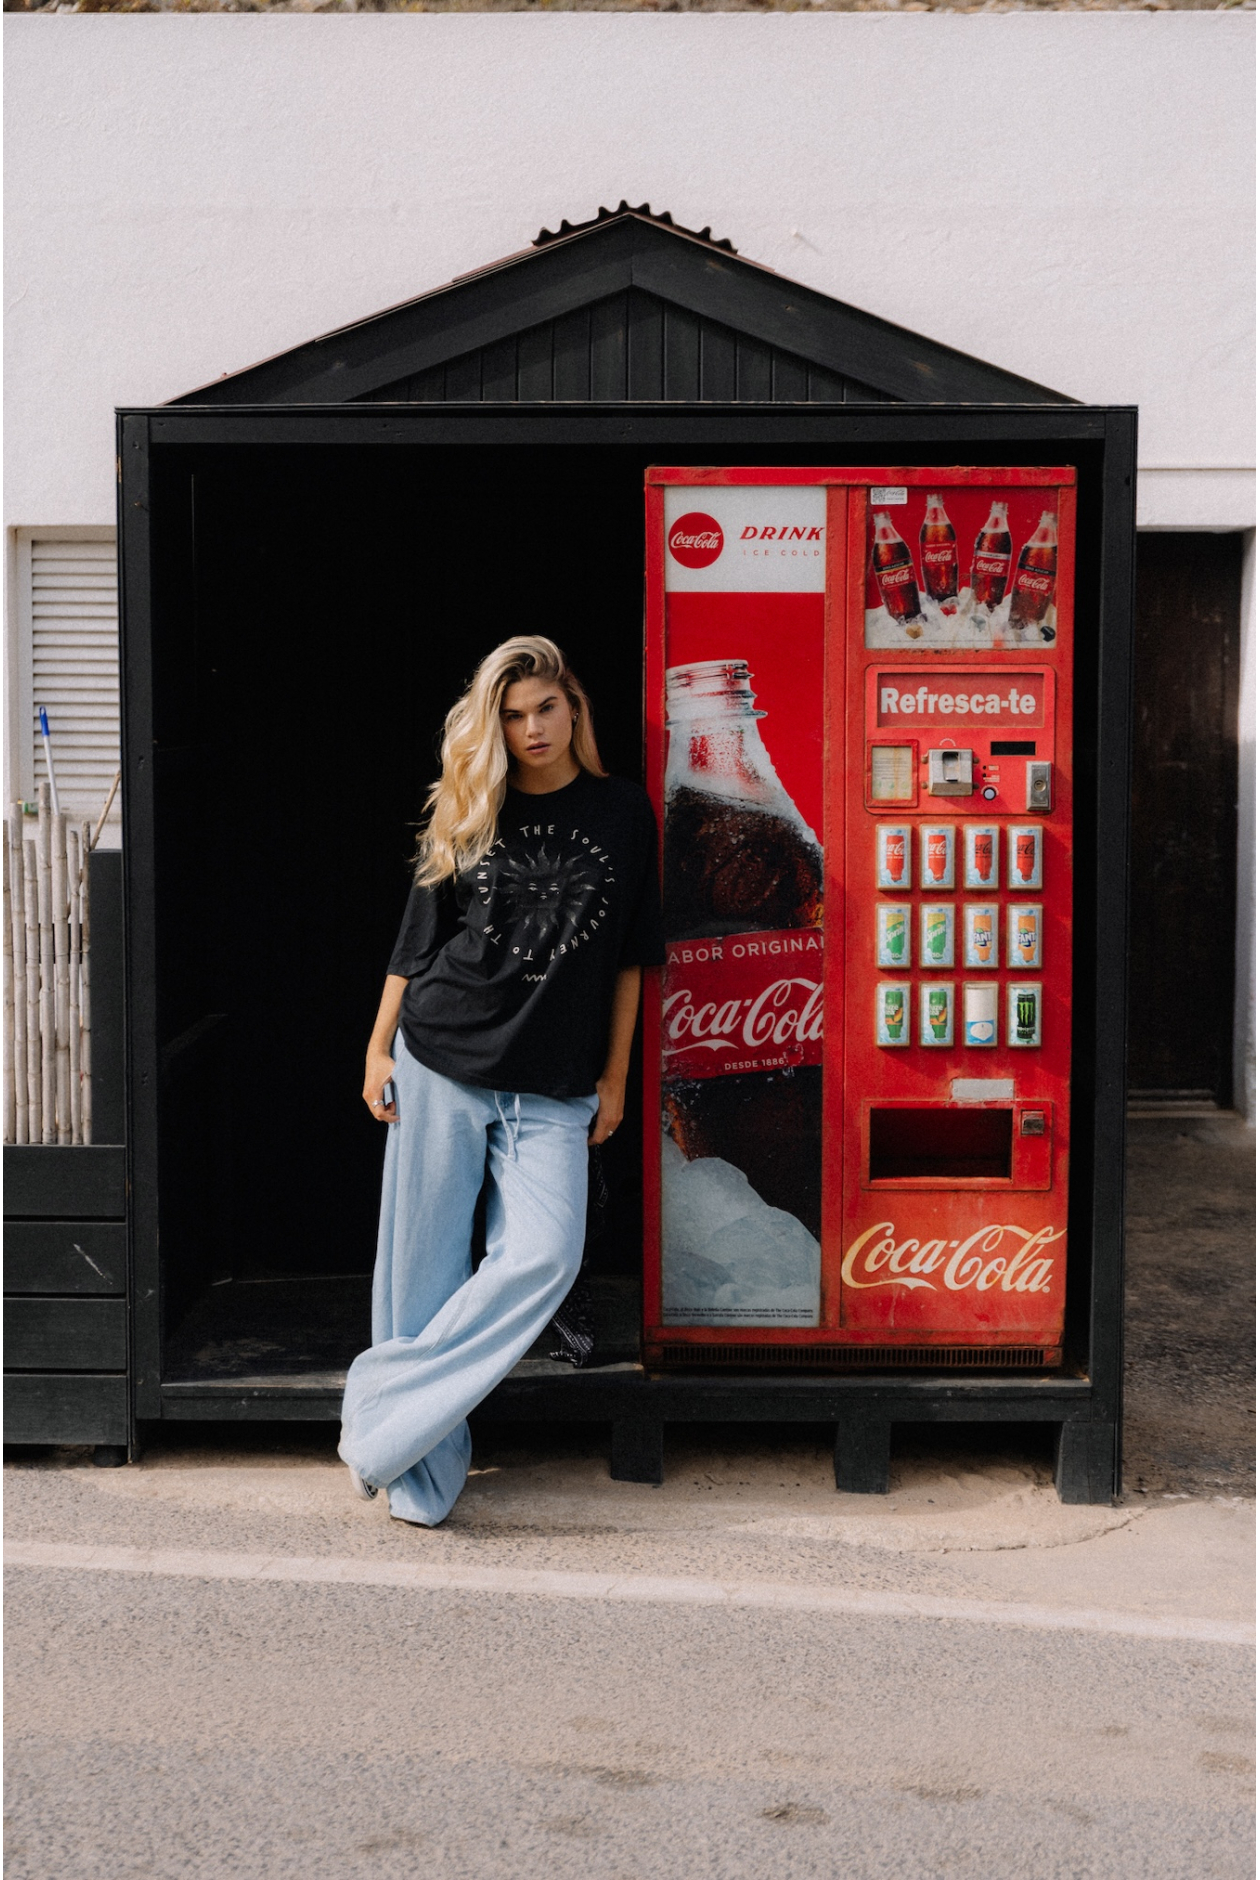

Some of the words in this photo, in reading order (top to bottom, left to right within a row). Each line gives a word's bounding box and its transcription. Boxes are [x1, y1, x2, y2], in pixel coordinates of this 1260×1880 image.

[671, 531, 722, 549] Coca-Cola
[740, 526, 825, 541] DRINK
[880, 686, 1036, 714] Refresca-te
[519, 824, 555, 838] THE
[570, 829, 615, 883] SOUL'S
[483, 924, 502, 945] TH
[512, 946, 534, 961] TO
[724, 1060, 758, 1071] DESDE
[762, 1057, 784, 1067] 1886
[841, 1221, 1067, 1293] Coca-Cola
